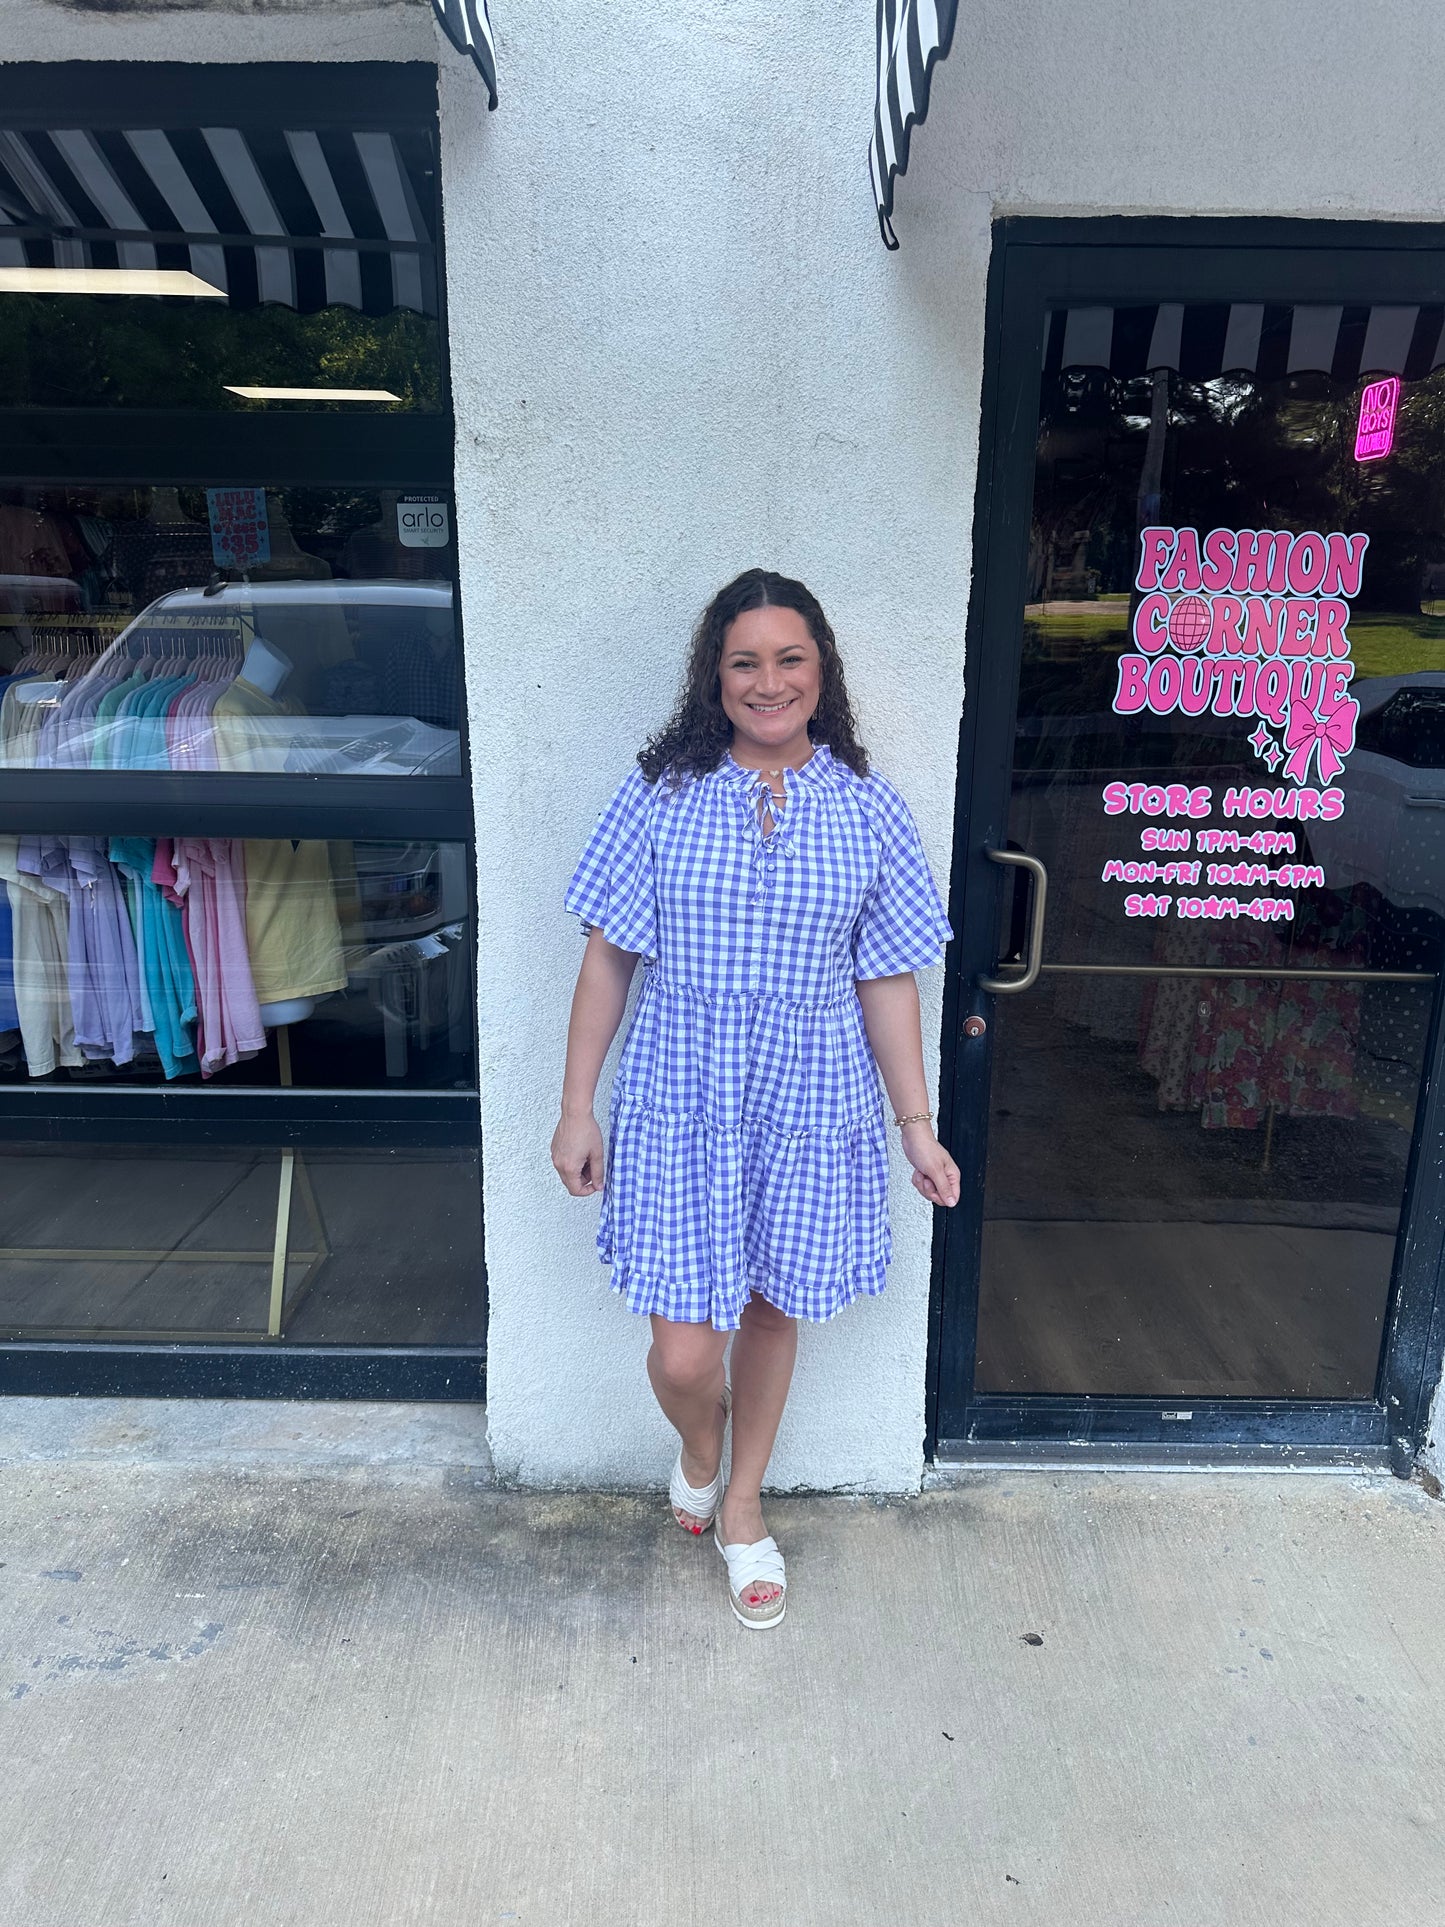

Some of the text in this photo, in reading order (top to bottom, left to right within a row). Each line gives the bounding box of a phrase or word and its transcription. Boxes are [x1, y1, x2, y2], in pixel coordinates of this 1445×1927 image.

[1366, 383, 1391, 414] NO
[1361, 409, 1391, 434] BOYS
[402, 506, 444, 528] arlo
[1136, 527, 1369, 597] FASHION
[1134, 593, 1350, 659] CORNER
[1113, 654, 1354, 726] BOUTIQUE
[1103, 782, 1345, 820] STORE HOURS
[1141, 828, 1296, 854] SUN 1PM-4PM
